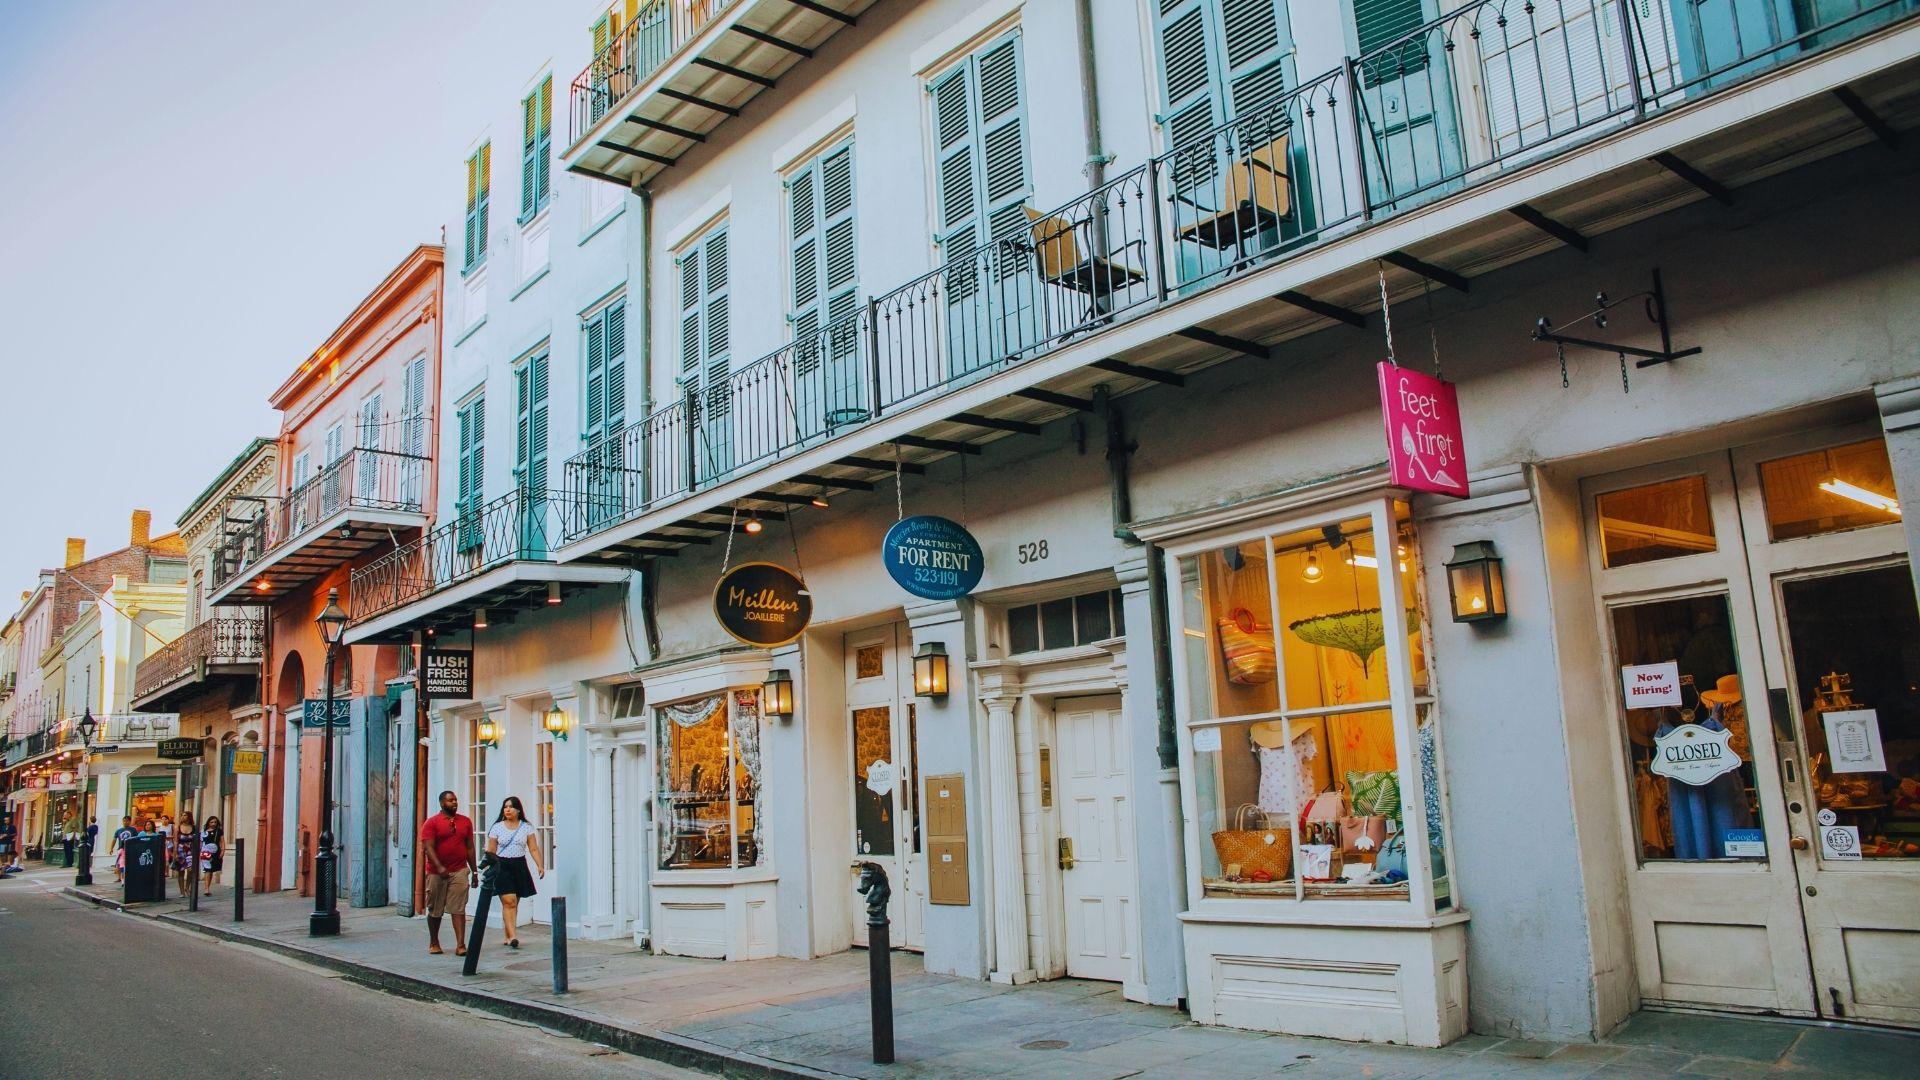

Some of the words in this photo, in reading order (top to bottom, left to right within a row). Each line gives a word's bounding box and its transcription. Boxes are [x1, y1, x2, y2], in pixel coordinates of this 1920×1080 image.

[1399, 377, 1440, 420] feet
[1416, 419, 1456, 467] first
[889, 526, 911, 550] Mercier
[911, 521, 933, 531] Realty
[934, 523, 942, 532] &
[906, 537, 963, 551] APARTMENT
[898, 545, 929, 567] FOR
[932, 550, 971, 571] RENT
[1018, 539, 1049, 565] 528
[728, 585, 799, 612] Meilleur
[744, 611, 785, 623] JOAILLERIE
[427, 655, 468, 667] LUSH
[427, 668, 468, 678] FRESH
[1637, 673, 1664, 683] Now
[1632, 684, 1673, 696] Hiring!
[163, 741, 199, 750] ELLIOTT
[1665, 742, 1721, 762] CLOSED
[1728, 832, 1759, 842] Google
[1829, 835, 1848, 844] BEST
